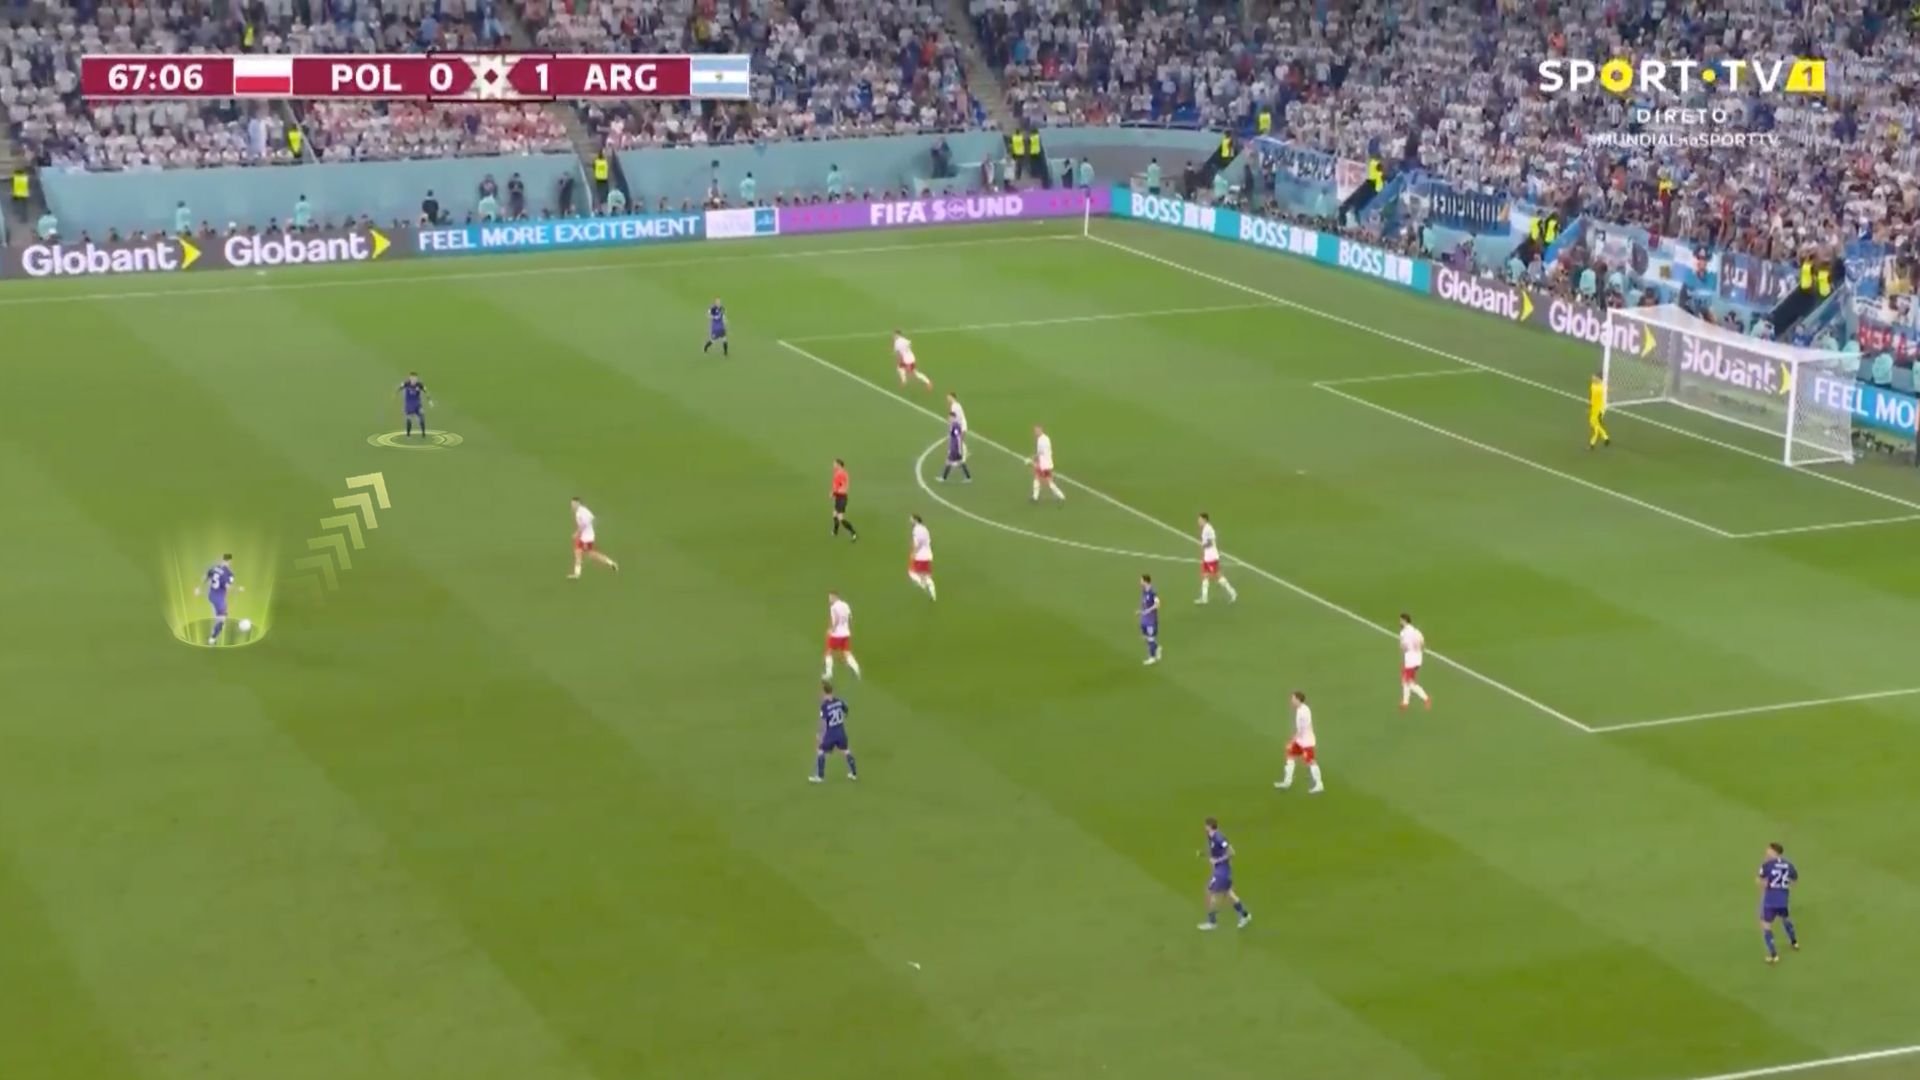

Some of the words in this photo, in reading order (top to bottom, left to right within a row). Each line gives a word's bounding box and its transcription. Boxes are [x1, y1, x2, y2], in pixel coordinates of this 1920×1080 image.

[869, 202, 927, 226] FIFA
[931, 195, 1024, 221] SOUND
[1131, 192, 1182, 226] BOSS
[224, 231, 369, 267] Globant
[418, 229, 477, 251] FEEL
[481, 223, 549, 247] MORE
[555, 215, 700, 241] EXCITEMENT
[1240, 213, 1288, 250] BOSS
[21, 238, 178, 276] Globant
[1339, 239, 1383, 275] BOSS
[1436, 267, 1520, 320] Globant
[1549, 299, 1641, 354] Globant
[1814, 376, 1869, 417] FEEL
[1875, 393, 1919, 432] MO
[828, 707, 844, 727] 20
